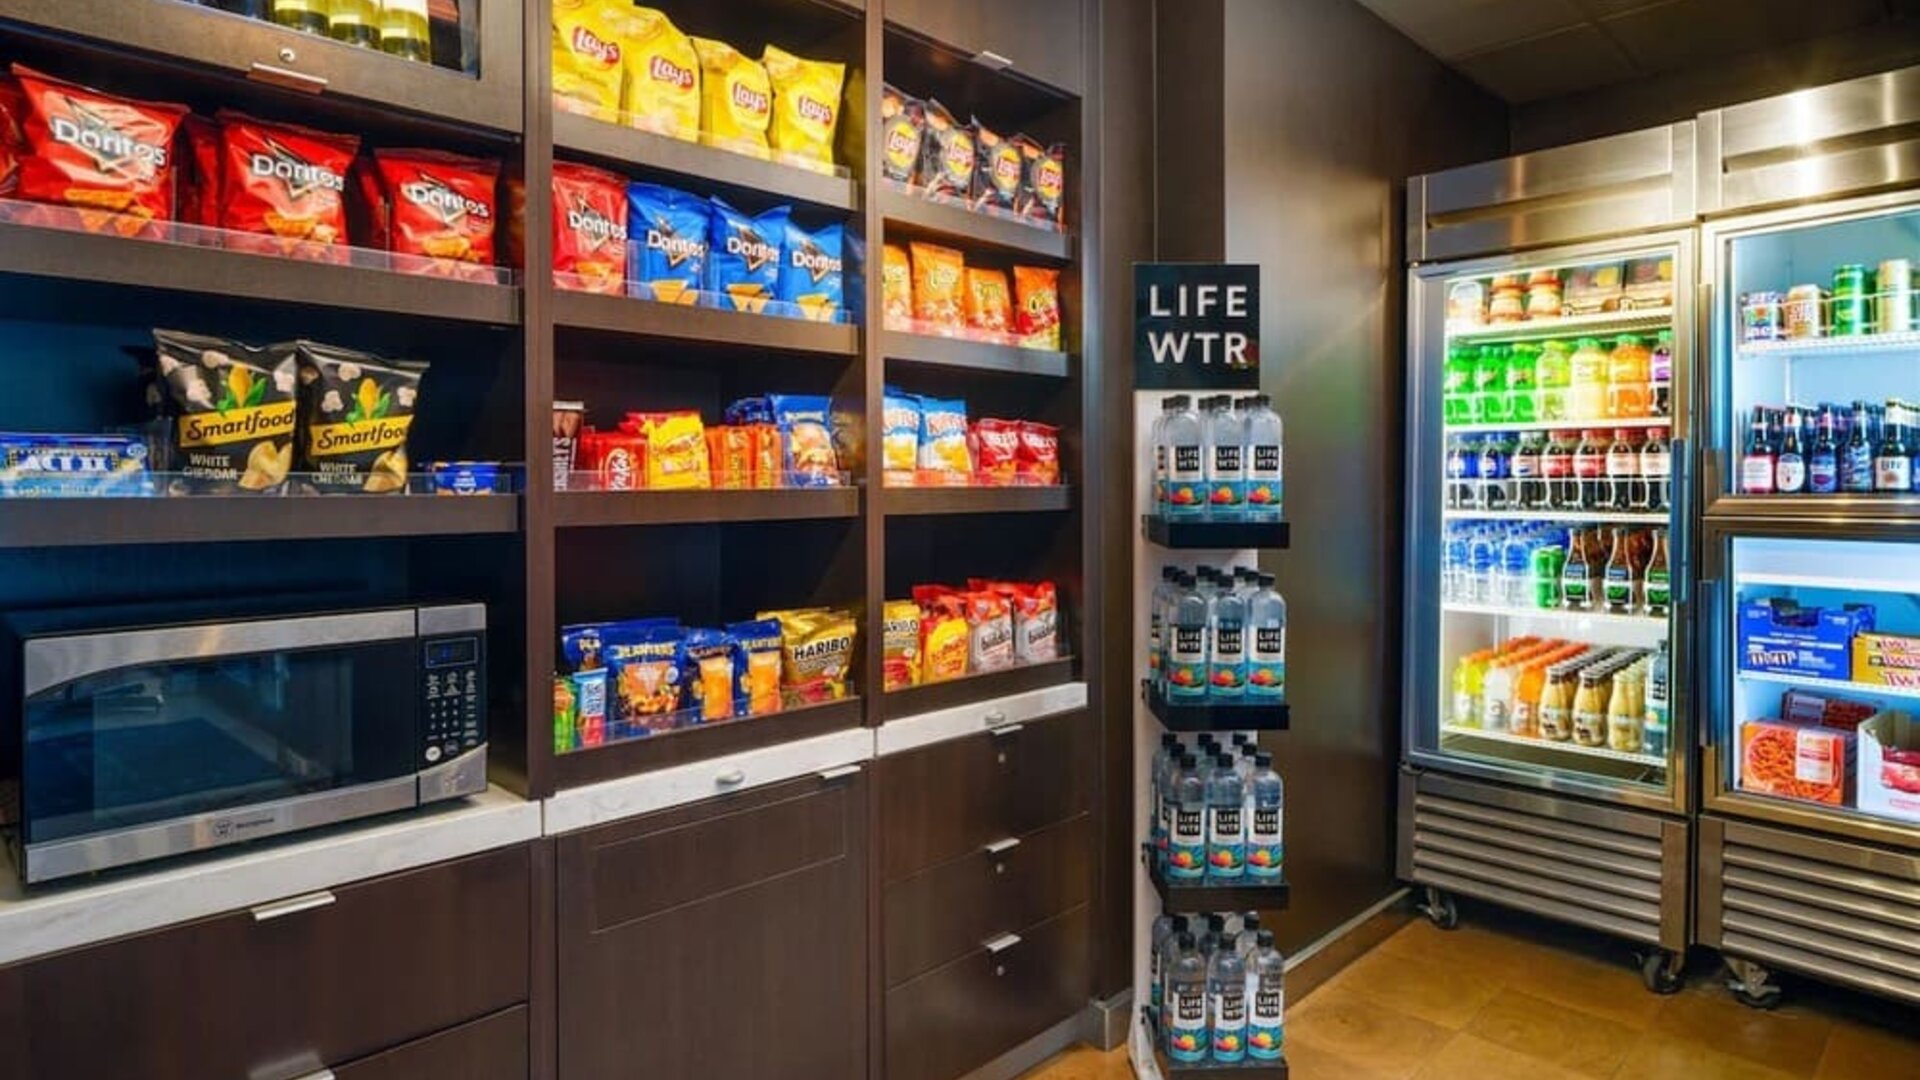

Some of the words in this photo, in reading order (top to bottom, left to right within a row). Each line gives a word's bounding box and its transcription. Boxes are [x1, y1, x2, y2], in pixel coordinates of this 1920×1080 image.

[53, 117, 167, 167] Doritos
[251, 153, 345, 193] Doritos
[410, 185, 490, 219] Doritos
[568, 210, 627, 240] Doritos
[647, 230, 705, 258] Doritos
[727, 236, 781, 263] Doritos
[791, 250, 842, 270] Doritos
[1149, 284, 1247, 318] LIFE
[1147, 331, 1248, 364] WTR
[186, 409, 294, 440] Smartfood
[317, 423, 404, 449] Smartfoo
[189, 453, 231, 468] WHITE
[319, 463, 358, 475] WHITE
[793, 637, 850, 661] HARIBO
